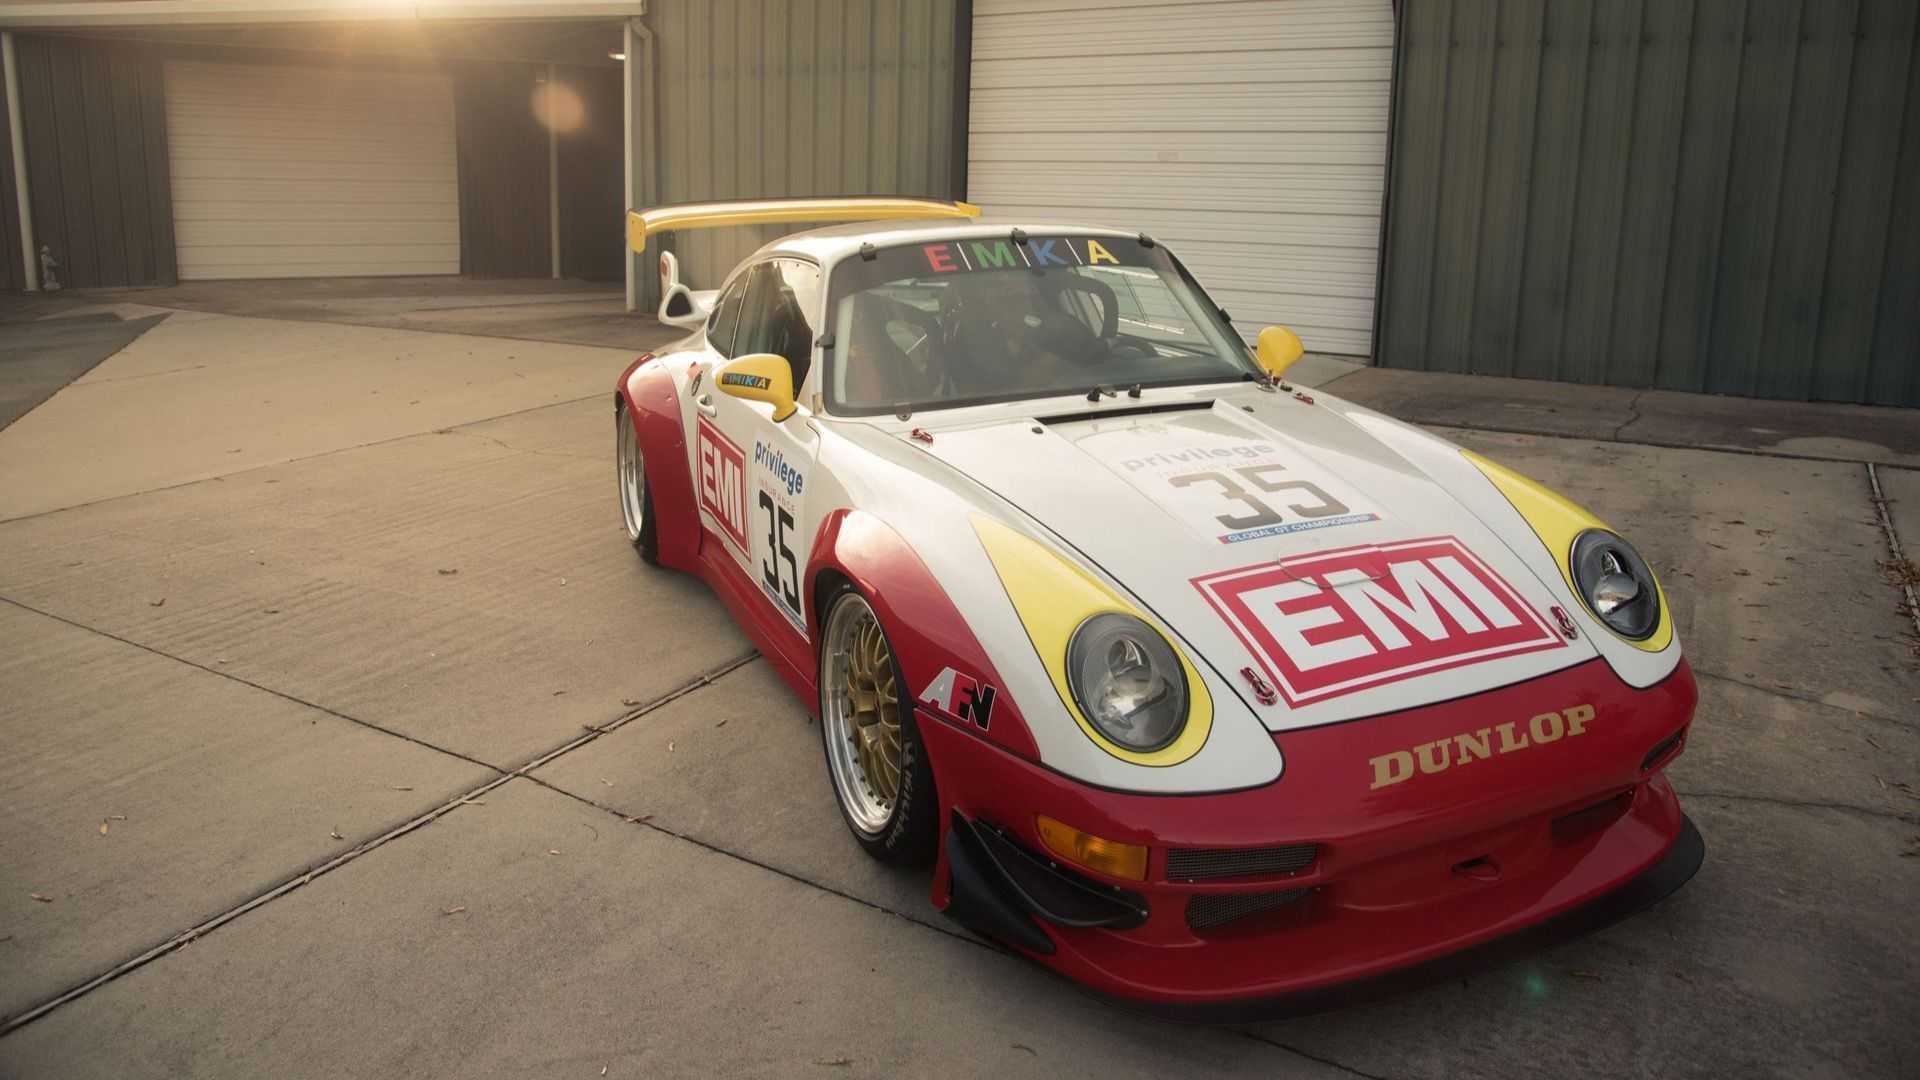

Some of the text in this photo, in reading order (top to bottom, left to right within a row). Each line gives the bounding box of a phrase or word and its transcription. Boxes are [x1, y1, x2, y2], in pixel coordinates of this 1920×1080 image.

[700, 433, 744, 538] EMI
[755, 439, 803, 496] privilege
[1120, 442, 1276, 471] privilege
[1168, 463, 1350, 530] 35
[759, 489, 801, 616] 35
[1227, 527, 1274, 542] GLOBAL
[1274, 524, 1291, 535] GT
[1236, 555, 1523, 672] EMI
[918, 666, 997, 732] AFN
[1368, 704, 1596, 790] DUNLOP
